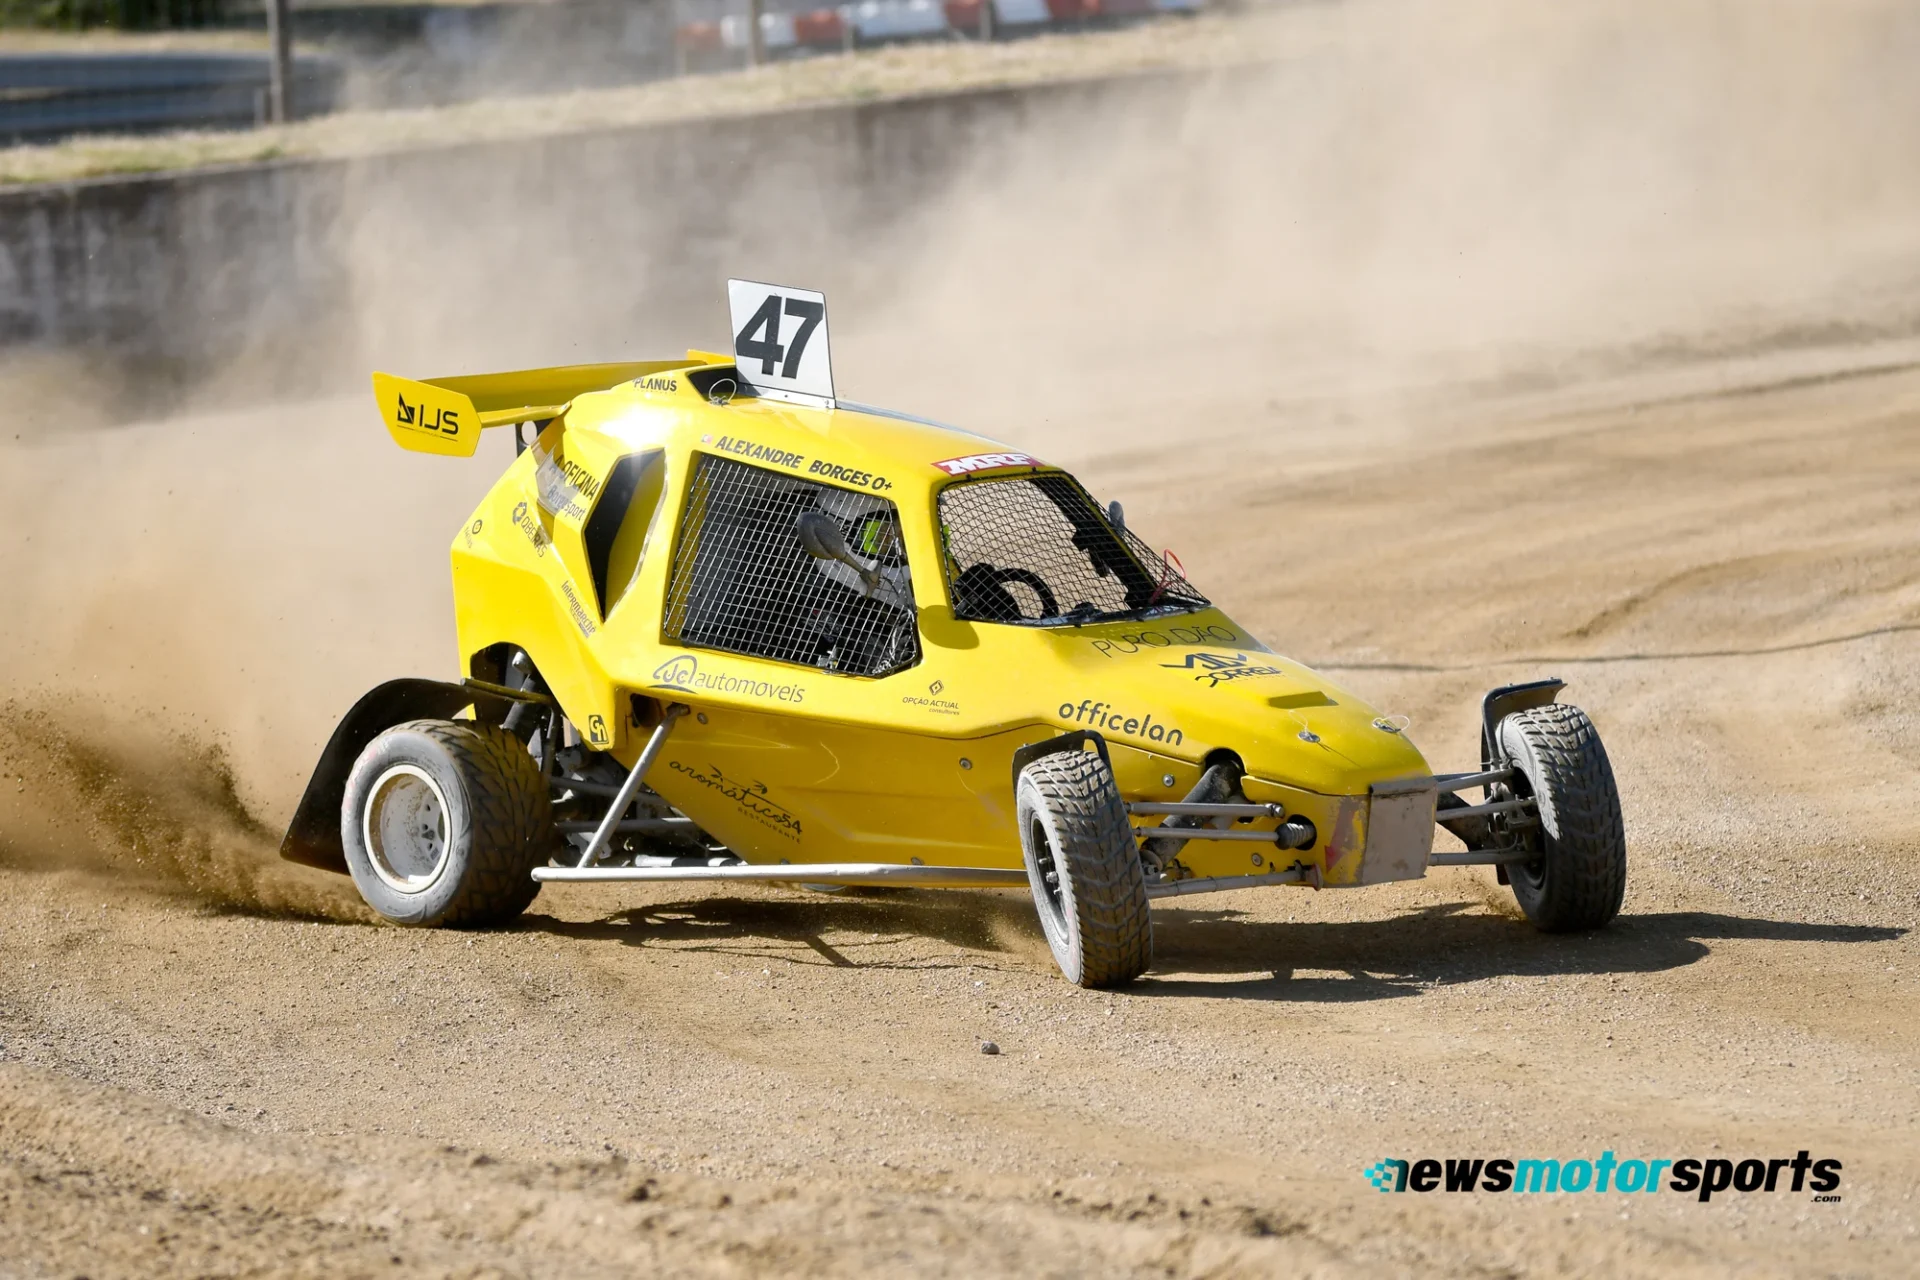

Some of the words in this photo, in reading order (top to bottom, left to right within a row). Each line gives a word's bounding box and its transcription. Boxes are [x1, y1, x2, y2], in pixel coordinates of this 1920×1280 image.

[735, 294, 824, 380] 47
[632, 376, 677, 392] PLANUS
[419, 403, 459, 436] IJS
[715, 435, 804, 470] ALEXANDRE
[808, 459, 873, 488] BORGES
[871, 477, 893, 492] O+
[938, 453, 1032, 475] MRF
[560, 460, 600, 501] OFICINA
[1091, 630, 1171, 659] PURO
[929, 699, 959, 710] ACTUAL
[1058, 699, 1184, 747] officelan
